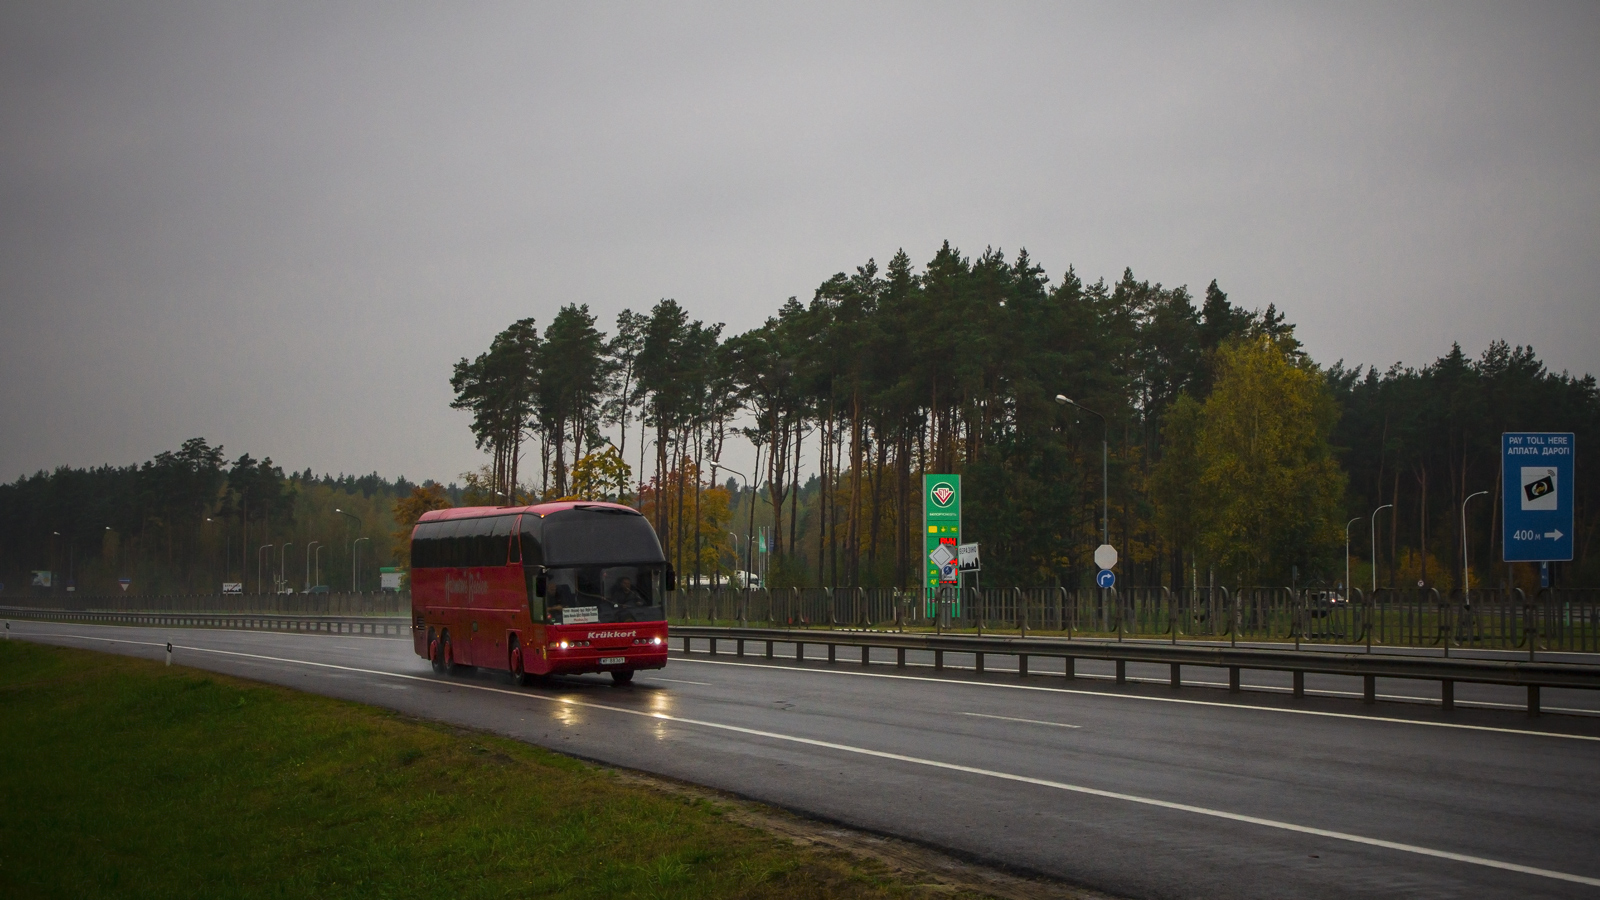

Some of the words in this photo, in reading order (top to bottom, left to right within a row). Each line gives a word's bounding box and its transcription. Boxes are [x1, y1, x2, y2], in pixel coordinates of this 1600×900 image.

[1509, 436, 1523, 445] PAY
[1526, 436, 1545, 445] TOLL
[1548, 436, 1568, 445] HERE
[1507, 447, 1539, 455] АПЛАТА
[1541, 447, 1570, 456] ДАРОГІ
[587, 630, 637, 639] Krükkert
